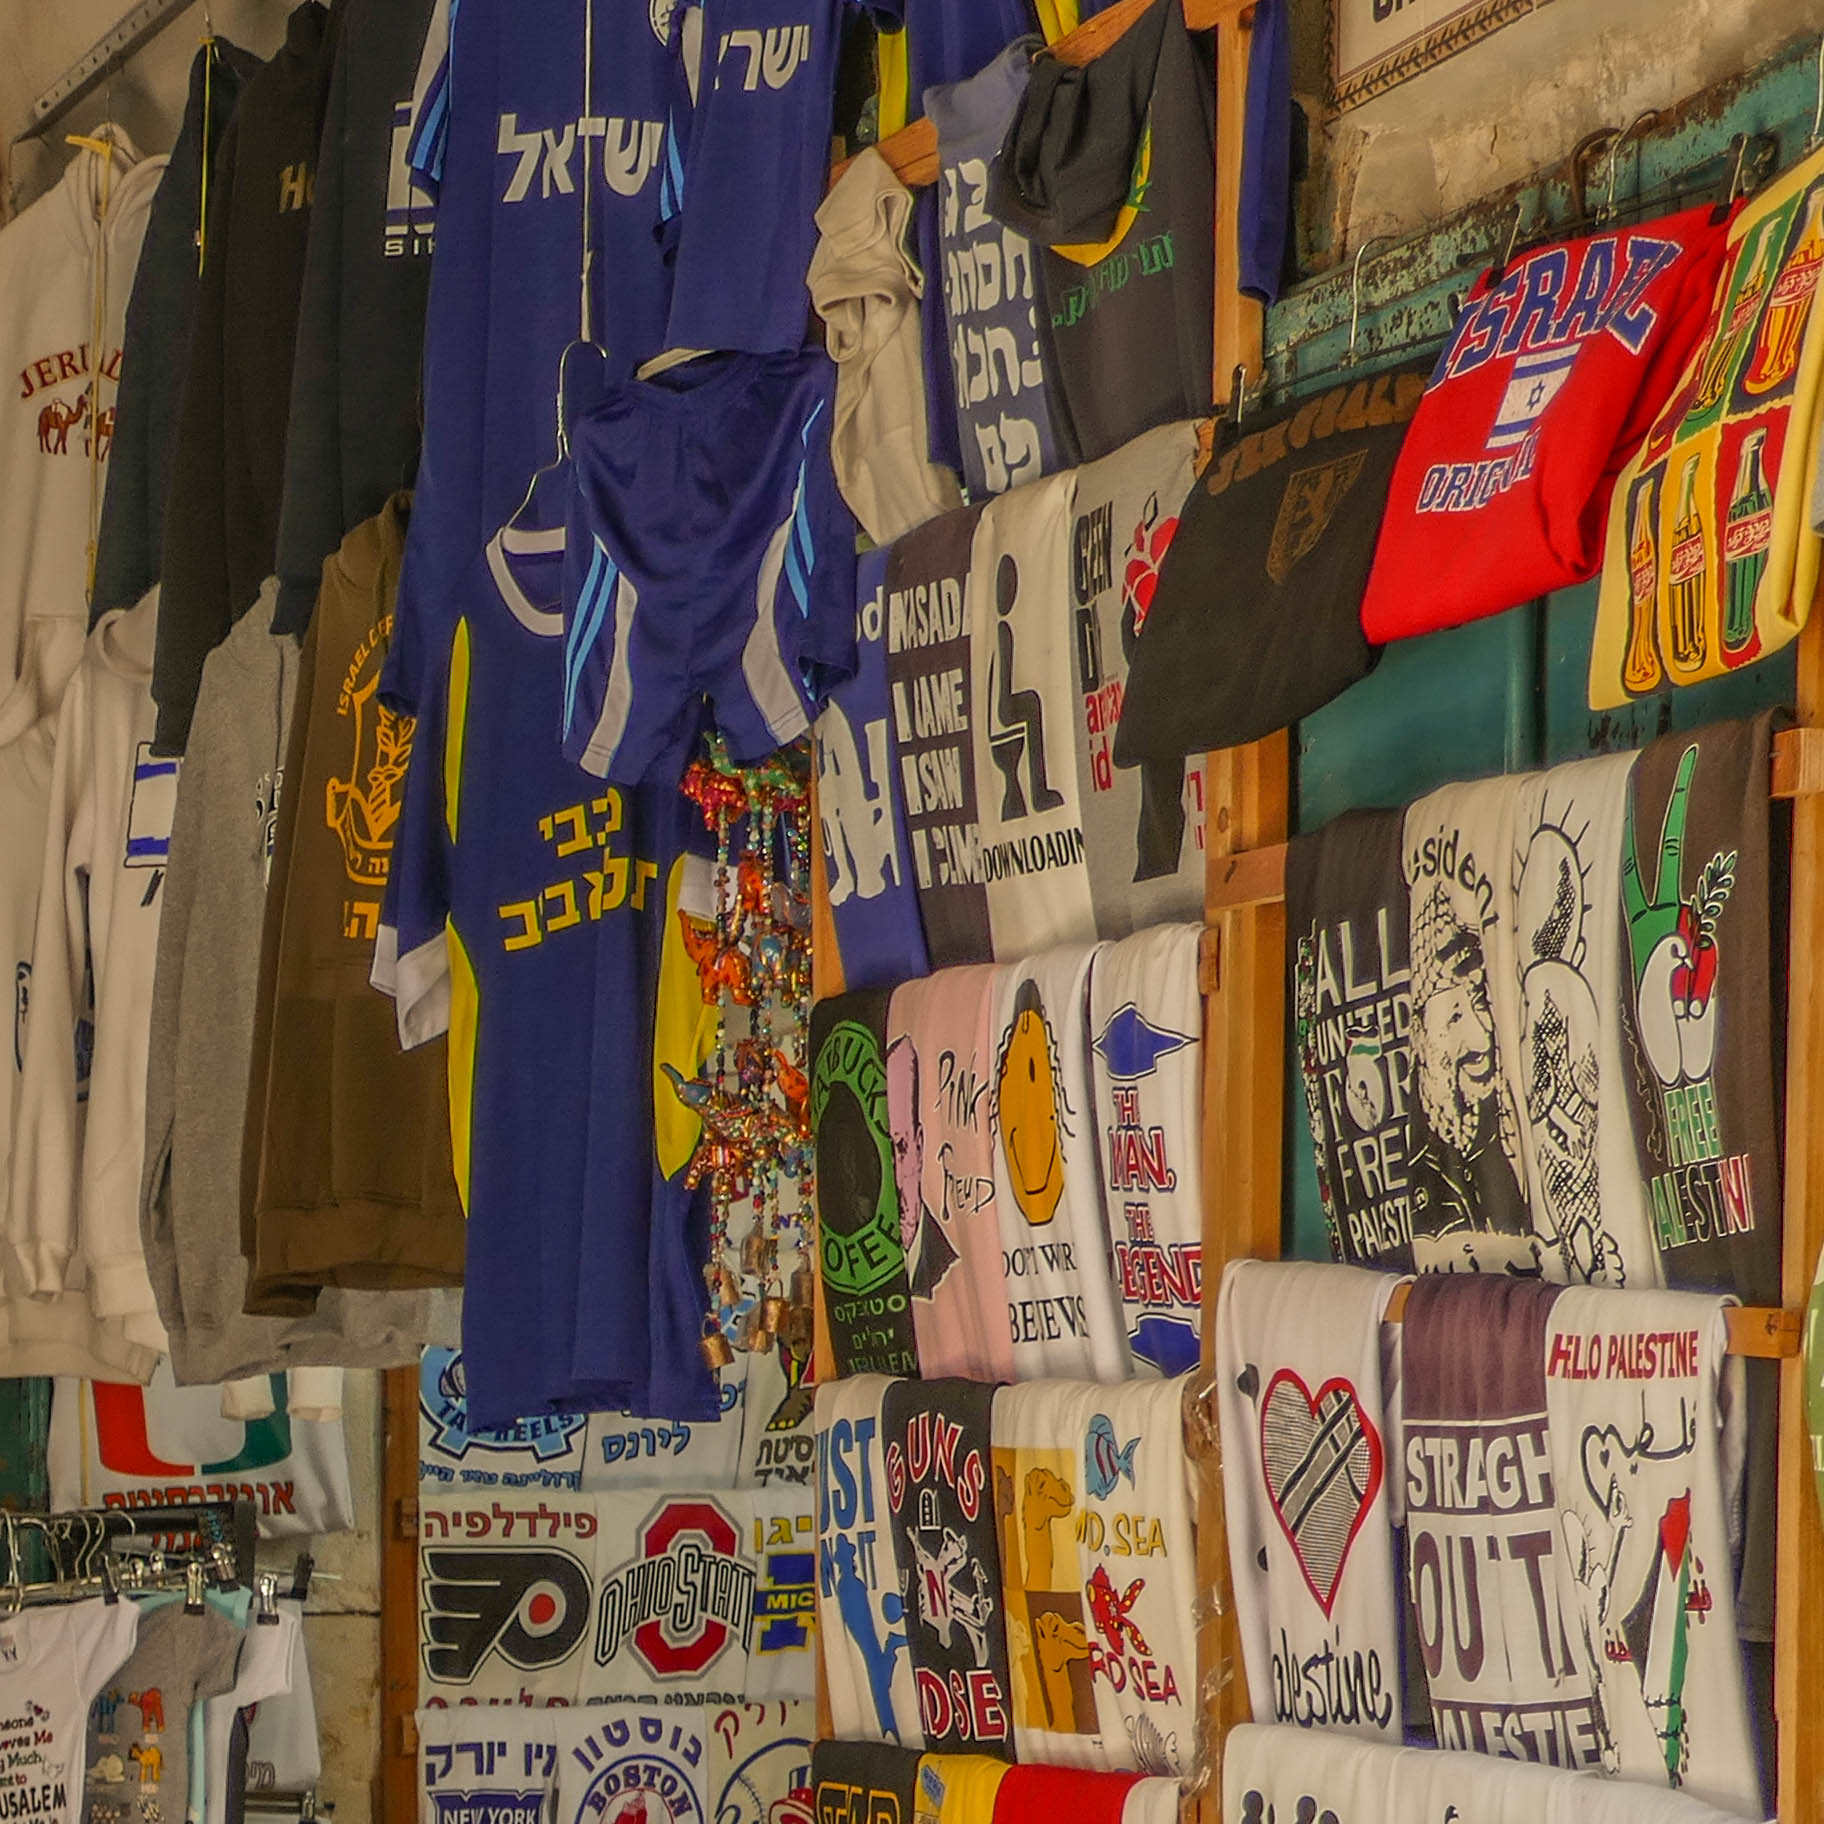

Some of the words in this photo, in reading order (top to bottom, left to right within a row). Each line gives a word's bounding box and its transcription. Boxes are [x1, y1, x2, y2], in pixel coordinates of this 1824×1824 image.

[1315, 908, 1409, 1015] ALL
[934, 1050, 989, 1134] PINK
[1606, 1330, 1699, 1380] PALESTINE
[886, 1411, 986, 1522] GUNS
[424, 1501, 598, 1539] פילדלפיה
[594, 1556, 676, 1668] OHIO
[8, 1752, 42, 1769] Much
[34, 1730, 53, 1745] Me
[425, 1741, 507, 1785] יורק
[571, 1715, 704, 1774] בוסטון
[16, 1774, 27, 1786] to
[586, 1763, 695, 1820] BOSTON
